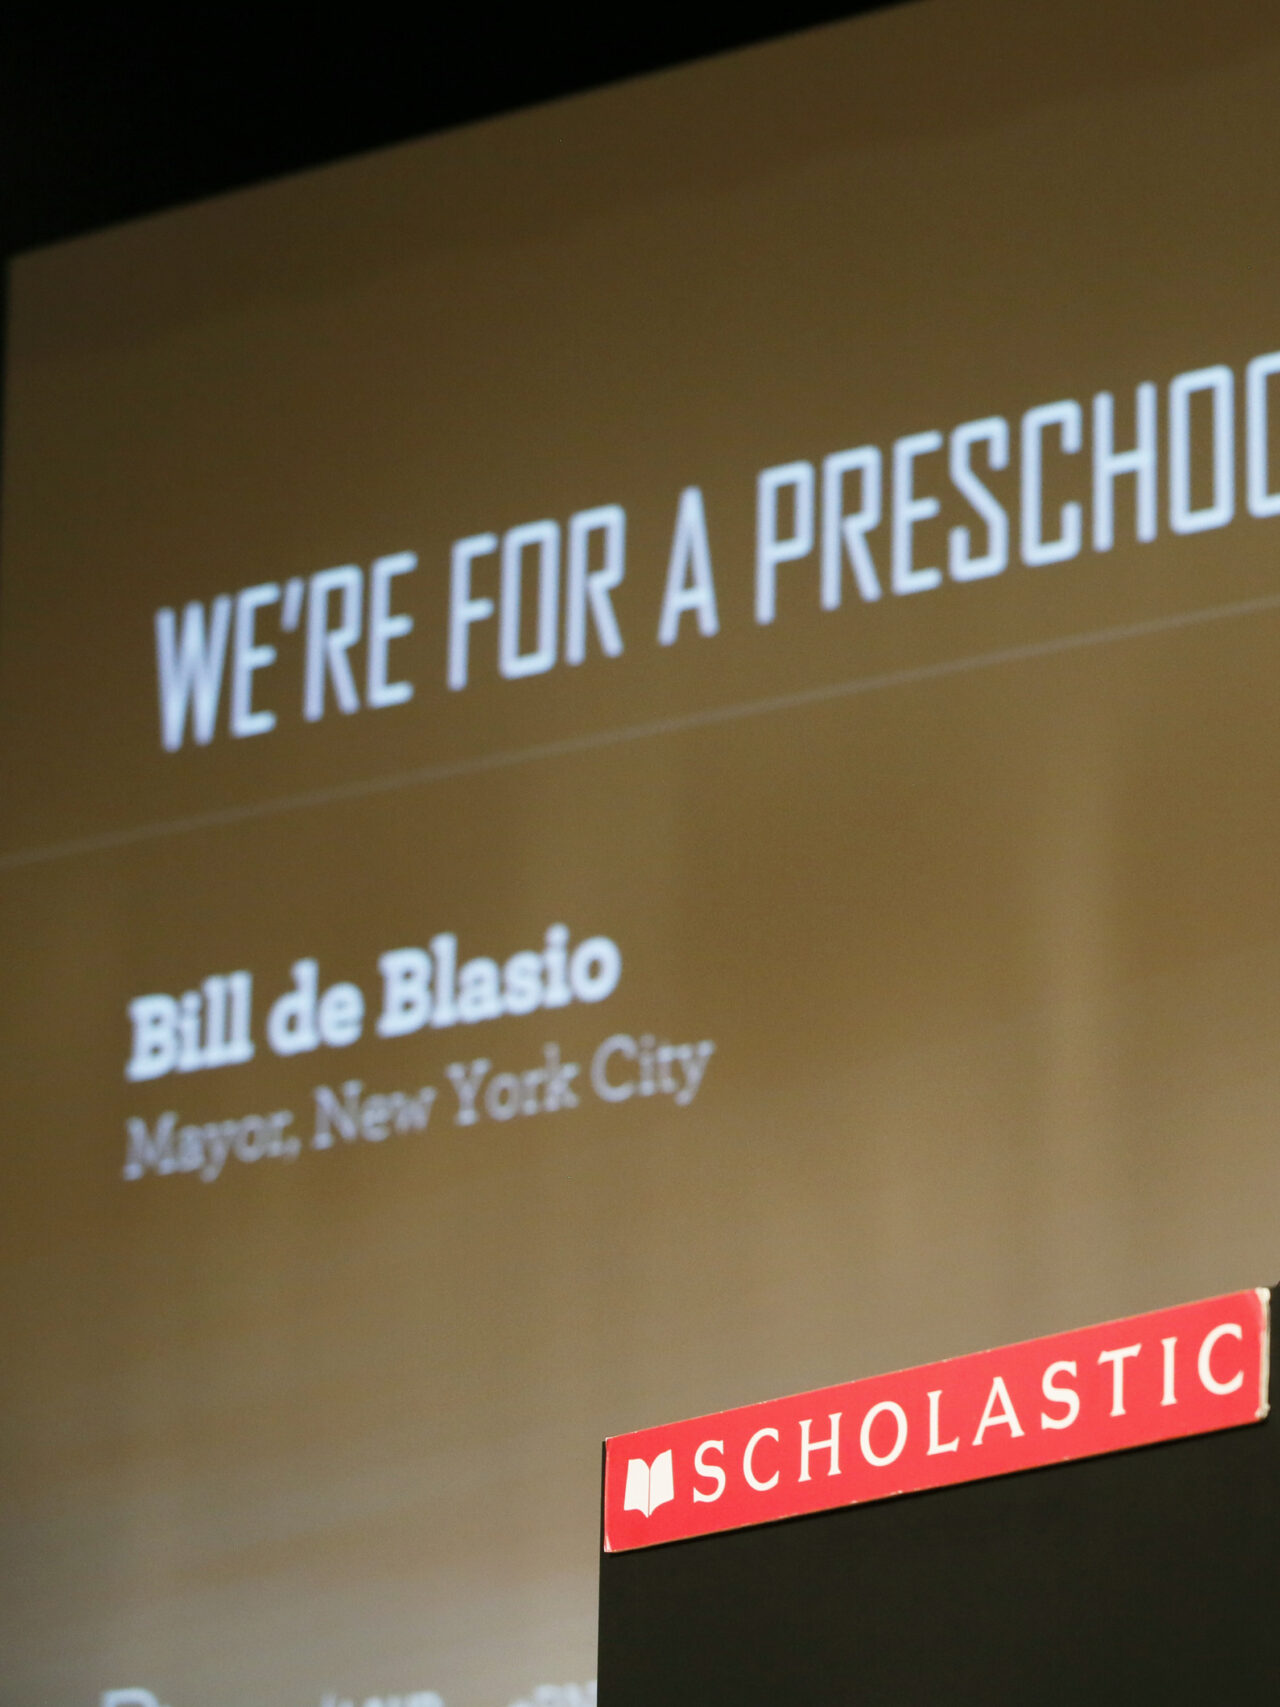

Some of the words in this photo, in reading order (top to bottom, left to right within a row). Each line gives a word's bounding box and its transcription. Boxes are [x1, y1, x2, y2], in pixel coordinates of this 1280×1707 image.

[156, 552, 418, 751] WE'RE
[447, 504, 627, 691] FOR
[658, 486, 720, 646] A
[125, 971, 255, 1082] Bill
[266, 958, 365, 1056] de
[376, 923, 622, 1038] Blasio
[124, 1111, 301, 1182] Mayor,
[313, 1080, 437, 1149] New
[446, 1043, 580, 1126] York
[590, 1034, 716, 1106] City
[692, 1323, 1245, 1504] SCHOLASTIC
